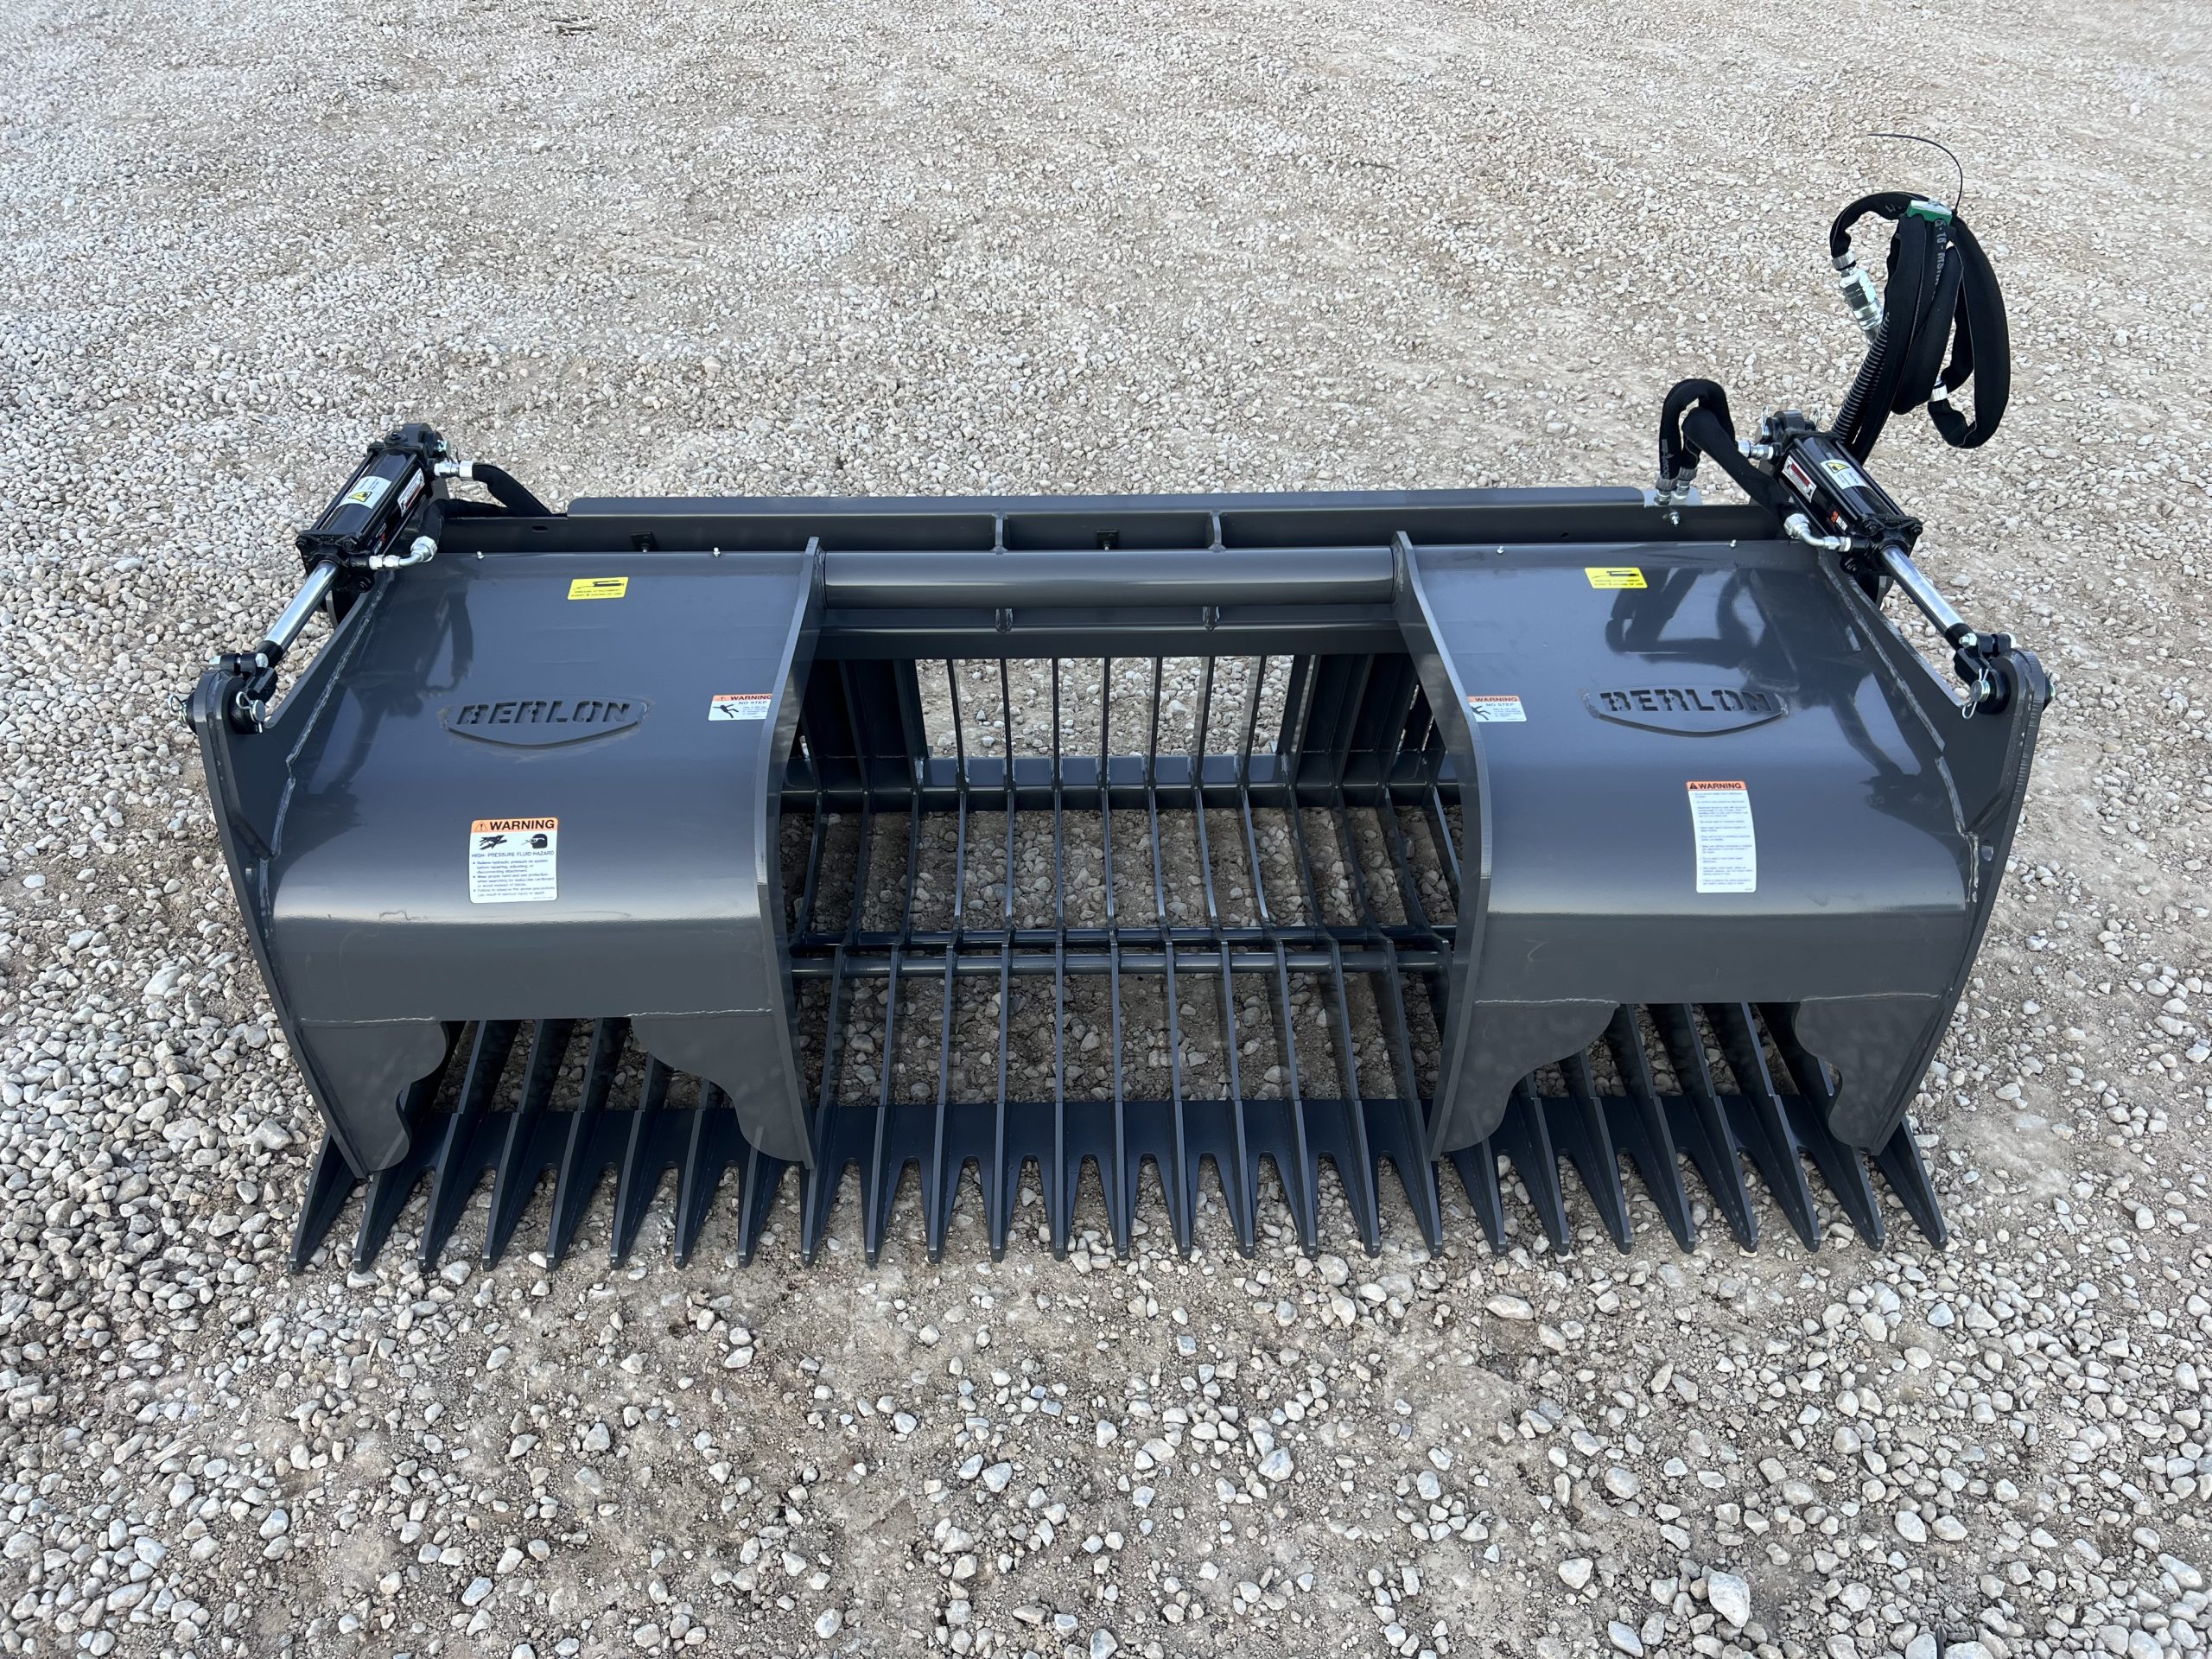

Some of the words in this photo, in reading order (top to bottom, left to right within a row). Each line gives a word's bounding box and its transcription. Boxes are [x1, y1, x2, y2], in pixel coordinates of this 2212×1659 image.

[1600, 689, 1773, 712] BERLON
[456, 700, 631, 725] BERLON
[489, 820, 555, 830] WARNING
